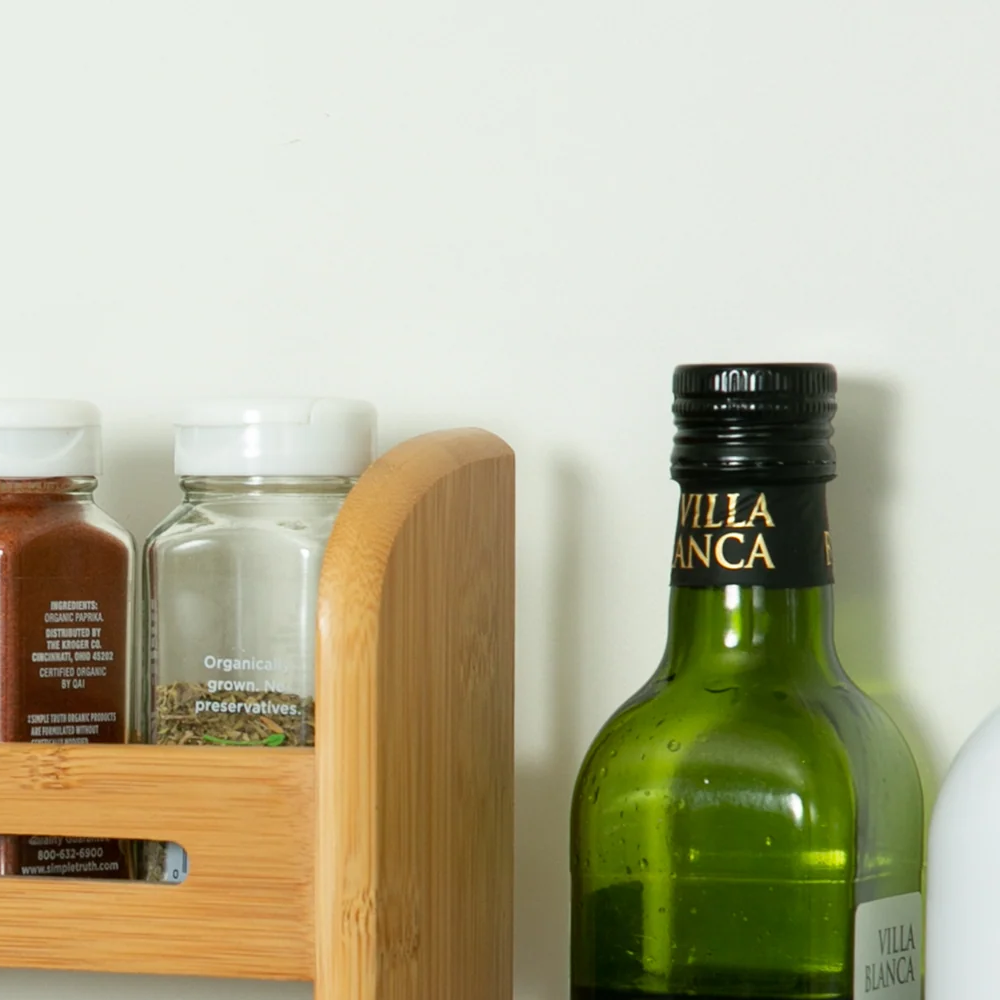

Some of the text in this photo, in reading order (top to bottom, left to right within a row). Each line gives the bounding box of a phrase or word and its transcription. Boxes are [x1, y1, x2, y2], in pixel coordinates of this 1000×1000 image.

[681, 492, 776, 528] VILLA
[672, 532, 776, 569] ANCA
[50, 600, 98, 610] INGREDIENTS:
[44, 613, 74, 623] ORGANIC
[45, 628, 102, 638] DISTRIBUTED BY
[46, 640, 102, 650] THE KROGER CO.
[32, 651, 114, 664] CINCINNATI, OHIO 45202
[39, 667, 107, 677] CERTIFIED ORGANIC
[61, 679, 85, 689] BY QAI
[207, 679, 259, 693] grown.
[195, 700, 302, 716] preservatives.
[67, 713, 90, 723] ORGANIC
[91, 712, 116, 722] PRODUCTS
[37, 847, 104, 861] 800-632-6900
[21, 861, 119, 876] www.simpletruth.com
[878, 923, 916, 955] VILLA
[864, 956, 915, 993] BLANCA
